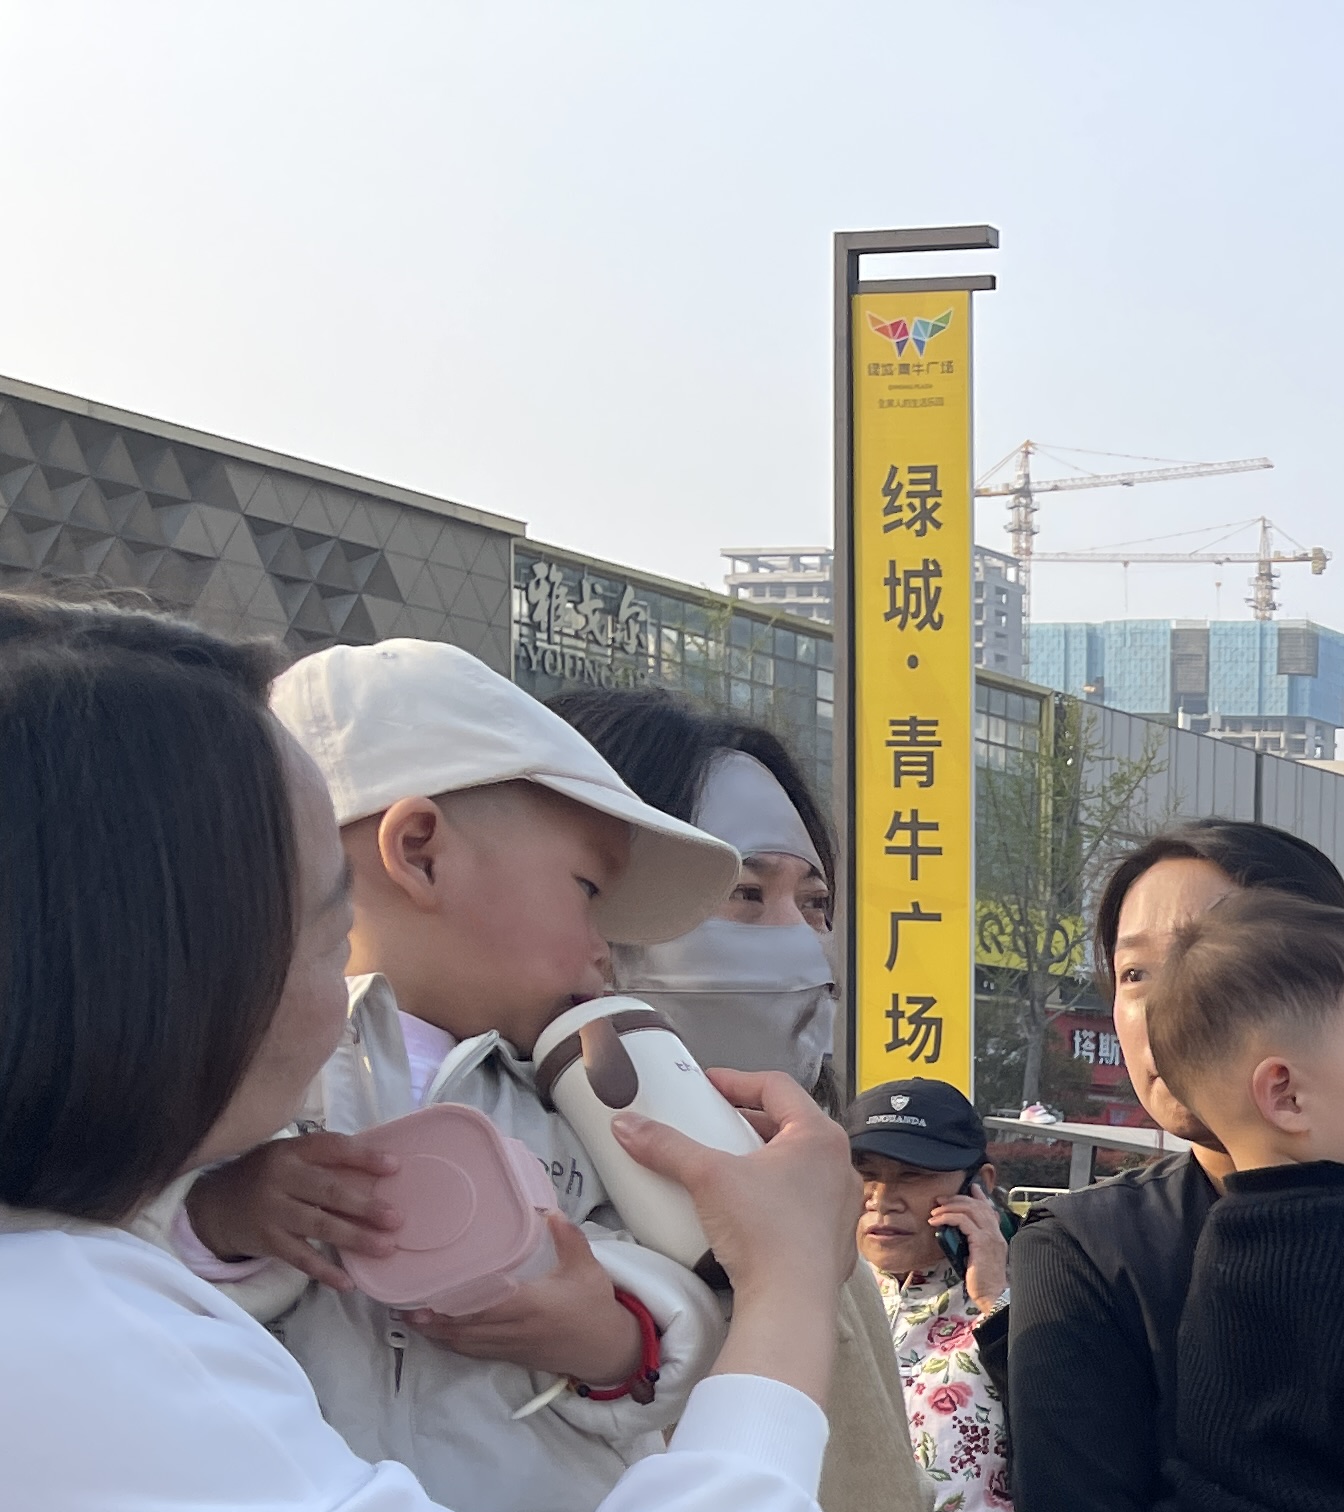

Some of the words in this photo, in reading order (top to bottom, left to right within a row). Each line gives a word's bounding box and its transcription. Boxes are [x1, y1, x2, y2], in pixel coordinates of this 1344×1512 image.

[882, 464, 944, 1065] 绿城·青牛广场
